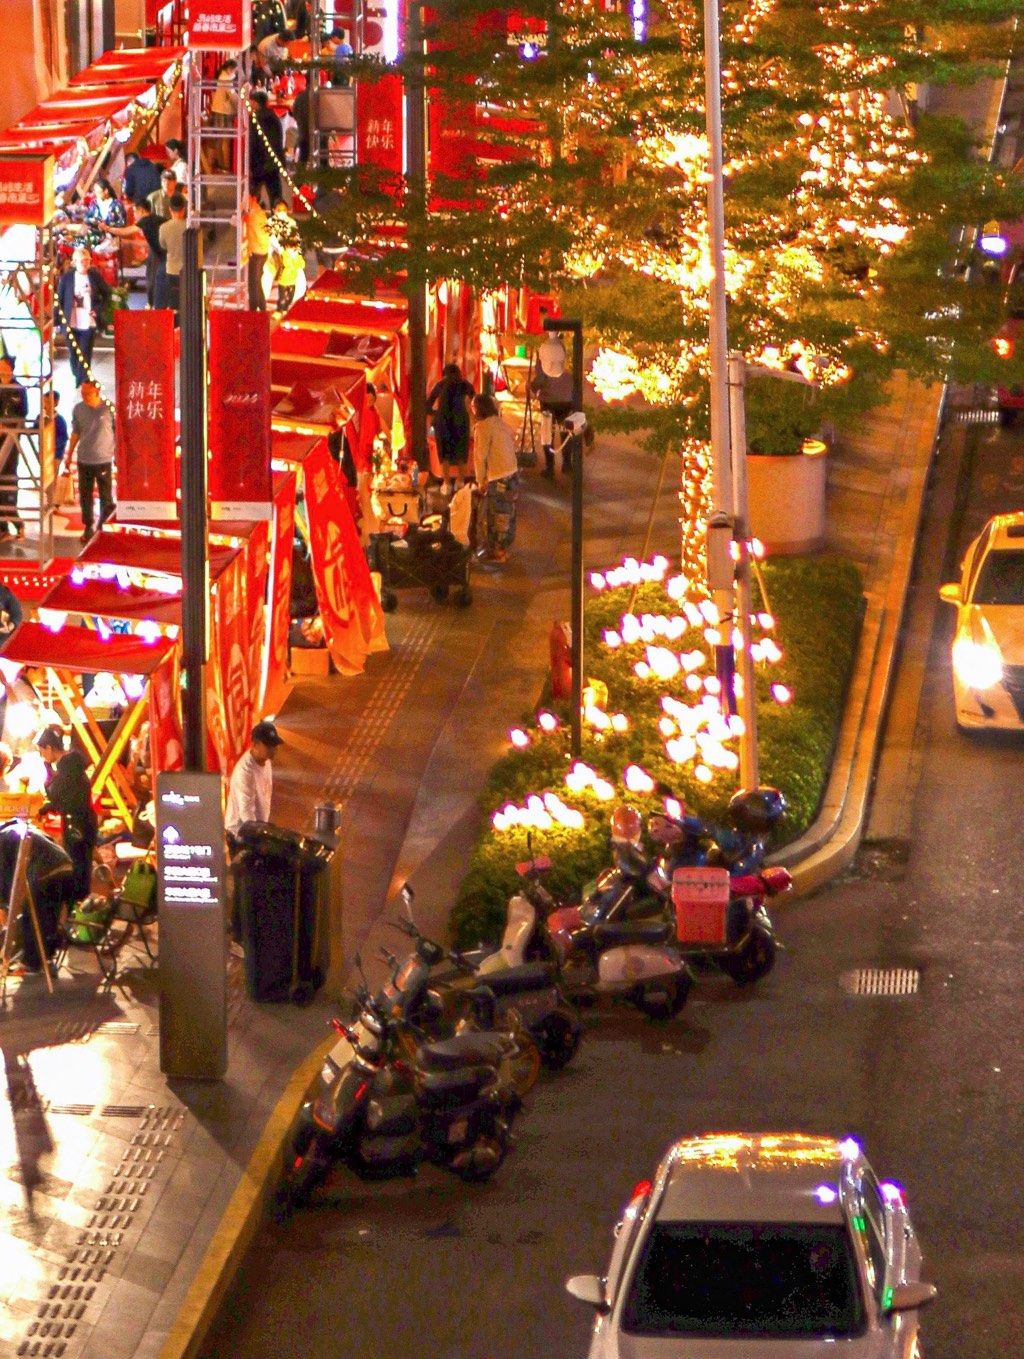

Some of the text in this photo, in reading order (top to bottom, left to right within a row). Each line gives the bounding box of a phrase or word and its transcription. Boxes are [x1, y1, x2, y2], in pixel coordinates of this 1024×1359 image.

[367, 118, 394, 134] 新年
[365, 134, 395, 150] 快乐
[127, 379, 163, 399] 新年
[126, 400, 164, 420] 快乐
